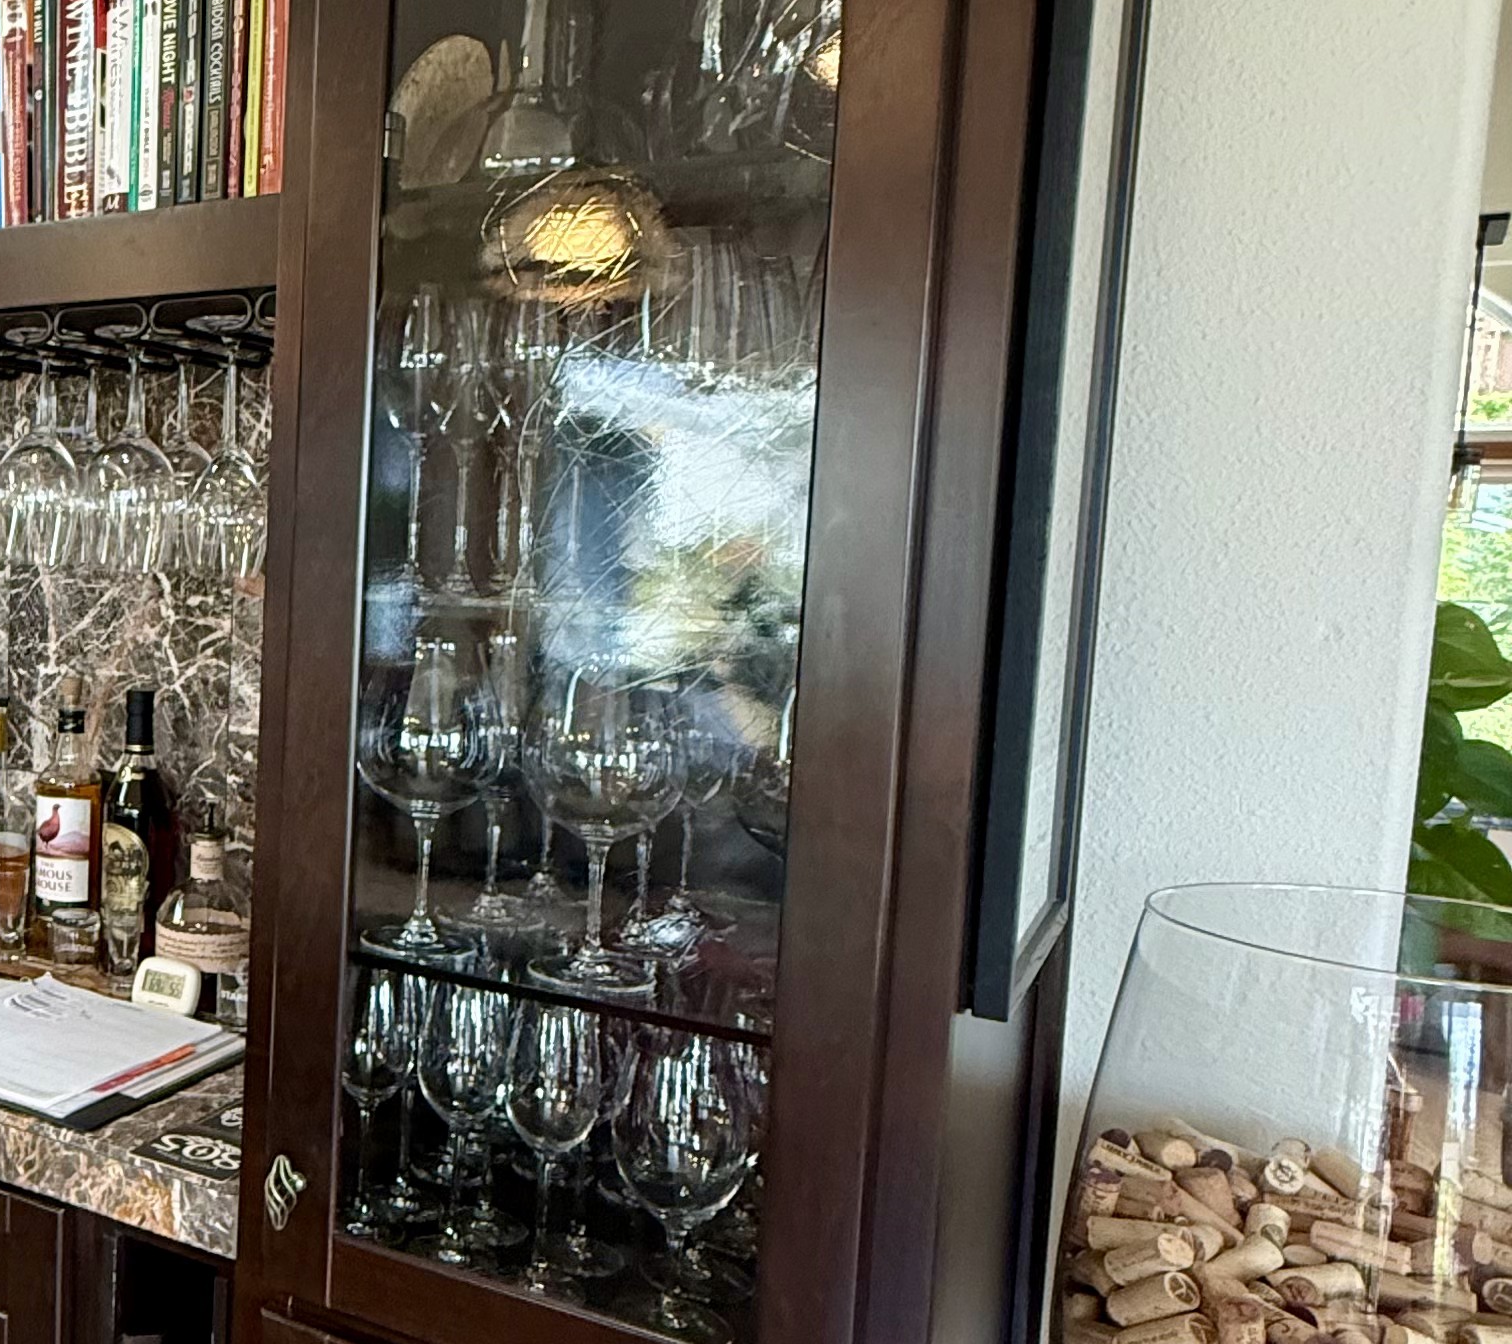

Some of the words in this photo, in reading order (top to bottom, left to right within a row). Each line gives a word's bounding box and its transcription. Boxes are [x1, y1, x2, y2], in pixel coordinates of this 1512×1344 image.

[65, 0, 90, 81] WINE
[161, 32, 177, 84] NIGHT
[208, 42, 224, 105] COCKTAILS
[63, 108, 89, 204] BIBLE
[150, 1133, 243, 1170] 805
